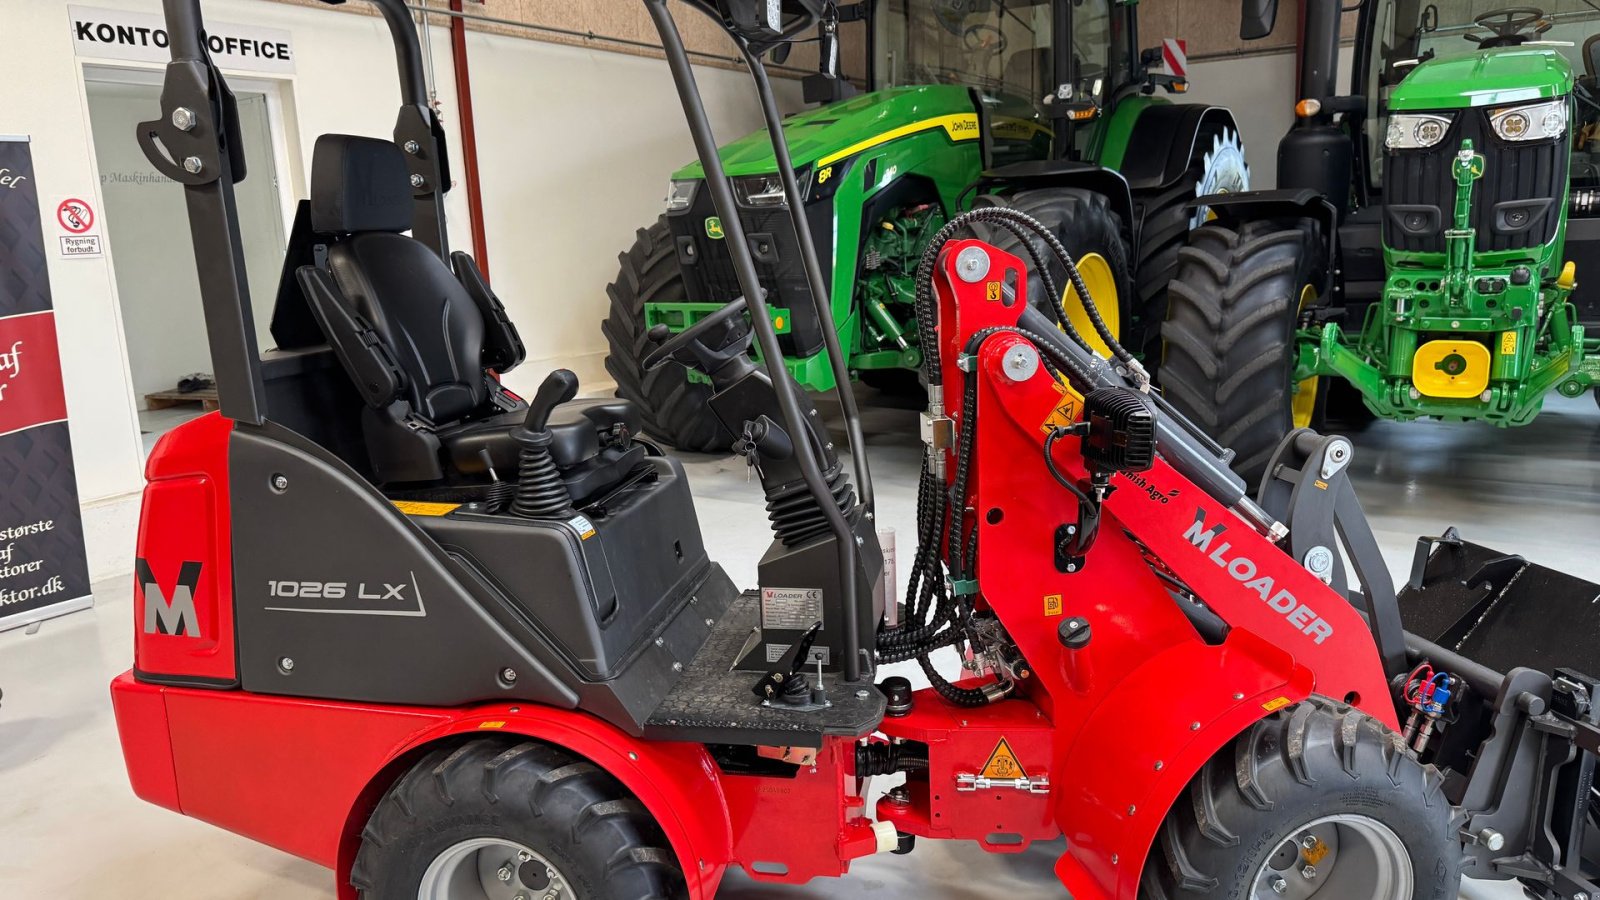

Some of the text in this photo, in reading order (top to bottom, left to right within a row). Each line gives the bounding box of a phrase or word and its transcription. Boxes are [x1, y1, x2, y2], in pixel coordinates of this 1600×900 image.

[75, 21, 290, 60] KONTO OFFICE
[818, 166, 832, 184] 8R
[65, 238, 96, 246] Rygning
[1145, 485, 1169, 504] Agro
[268, 580, 406, 600] 1026 LX
[1208, 542, 1333, 647] LOADER
